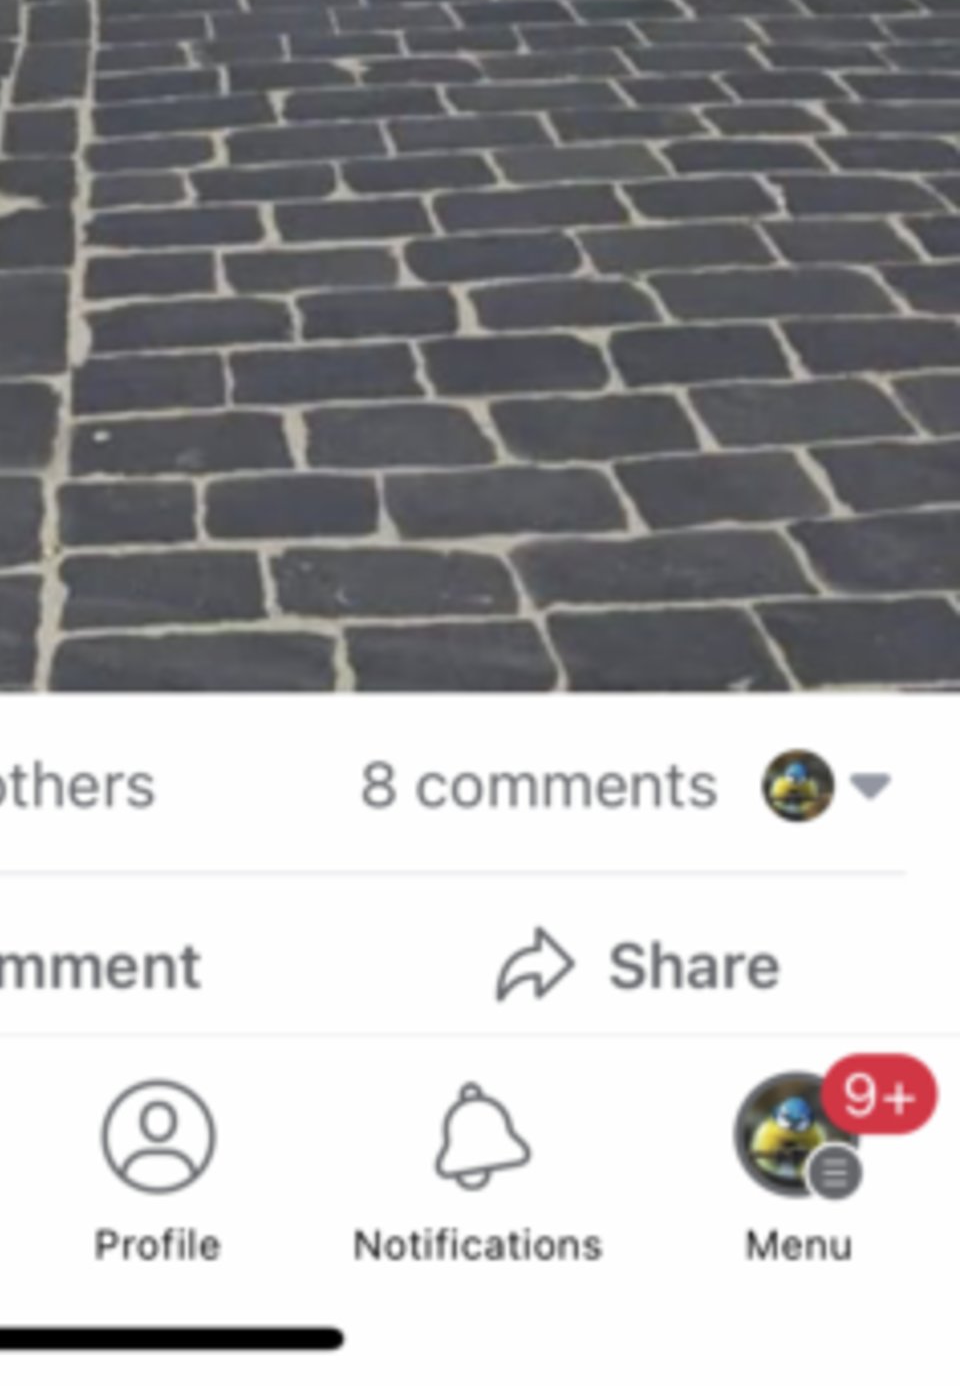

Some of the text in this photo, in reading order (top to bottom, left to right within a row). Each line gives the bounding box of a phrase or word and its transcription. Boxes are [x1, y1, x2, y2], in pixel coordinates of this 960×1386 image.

[363, 761, 716, 808] 8 comments
[611, 941, 779, 989] Share
[845, 1074, 913, 1116] 9+
[95, 1227, 221, 1261] Profile
[354, 1228, 602, 1261] Notifications
[747, 1229, 851, 1261] Menu
